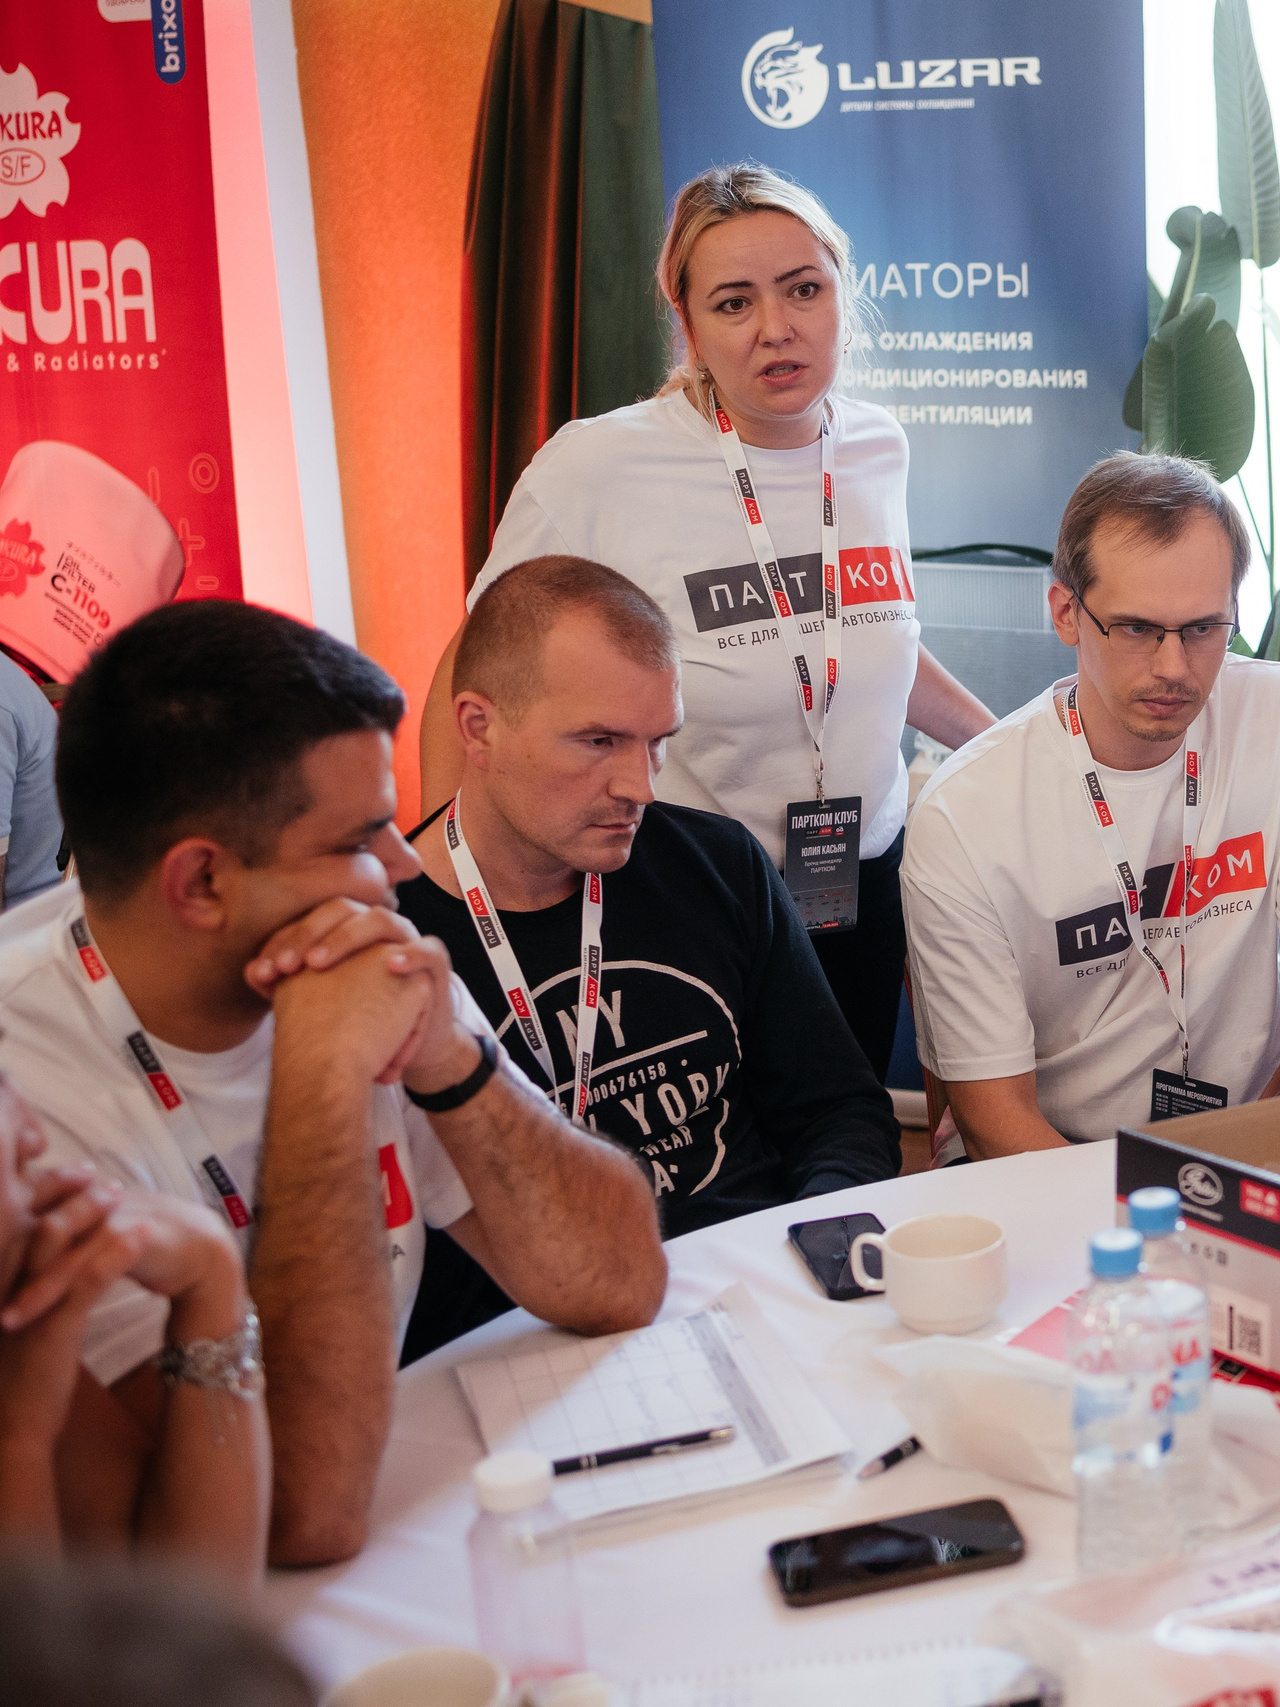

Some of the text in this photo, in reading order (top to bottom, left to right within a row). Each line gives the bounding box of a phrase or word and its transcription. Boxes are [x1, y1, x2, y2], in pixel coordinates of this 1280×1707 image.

[836, 56, 1043, 91] LUZAR
[0, 111, 62, 140] KURA
[851, 262, 1029, 299] ИАТОРЫ
[879, 332, 1033, 353] ОХЛАЖДЕНИЯ
[7, 351, 160, 372] & Radiators
[739, 472, 751, 496] ПАРТ
[748, 503, 759, 522] КОМ
[708, 571, 807, 612] ПАТ
[768, 565, 781, 588] ПАРТ
[778, 595, 789, 615] КОМ
[718, 633, 746, 649] ВСЕ
[751, 627, 780, 646] ДЛЯ
[799, 620, 826, 635] ШЕГ
[798, 658, 809, 682] ПАРТ
[1071, 714, 1079, 733] КОМ
[1089, 775, 1100, 798] ПАРТ
[1099, 804, 1109, 824] КОМ
[791, 810, 858, 829] ПАРТКОМ КЛУБ
[448, 823, 457, 846] ПАРТ
[801, 846, 821, 857] ЮЛИЯ
[1121, 866, 1133, 887] ПАРТ
[1185, 849, 1252, 901] КОМ
[470, 891, 496, 945] ПАРТ КОМ
[590, 949, 598, 975] ПАРТ
[1076, 966, 1102, 979] ВСЕ
[1107, 955, 1130, 971] ДЛ
[512, 991, 526, 1013] КОМ
[523, 1022, 539, 1047] ПАРТ
[1156, 1082, 1223, 1106] ПРОГРАММА МЕРОПРИЯТИЯ
